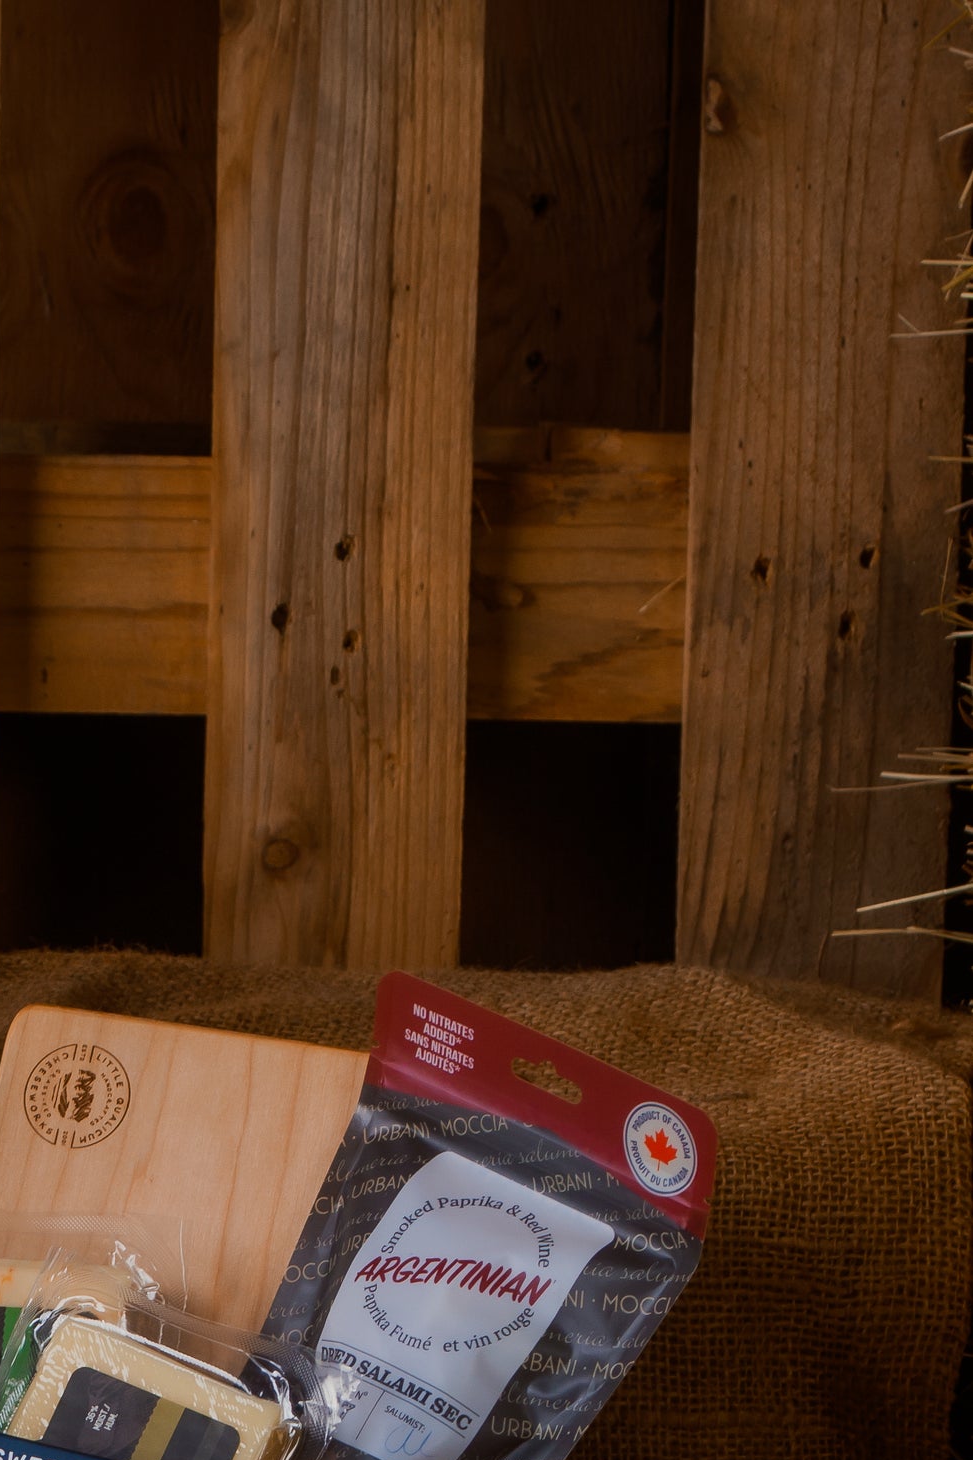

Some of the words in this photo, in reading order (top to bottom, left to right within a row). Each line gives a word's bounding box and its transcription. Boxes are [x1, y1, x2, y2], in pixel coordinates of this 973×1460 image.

[412, 1003, 427, 1019] NO
[428, 1010, 475, 1041] NITRATES
[96, 1053, 124, 1088] LITTLE
[404, 1028, 429, 1049] SANS
[430, 1040, 475, 1069] NITRATES
[29, 1052, 69, 1135] CHEESEWORKS
[79, 1097, 125, 1144] QUALICUM
[363, 1121, 431, 1145] URBANI
[440, 1113, 509, 1137] MOCCIA
[632, 1110, 661, 1132] PRODUCT
[662, 1114, 672, 1125] OF
[672, 1122, 691, 1159] CANADA
[532, 1172, 592, 1194] URBANI
[630, 1140, 651, 1178] PRODUIT
[650, 1174, 661, 1186] DU
[663, 1167, 689, 1187] CANADA
[381, 1200, 435, 1254] Smoked
[438, 1196, 504, 1210] Paprika
[506, 1205, 521, 1217] &
[520, 1212, 547, 1234] Red
[537, 1233, 554, 1268] Wine
[613, 1231, 689, 1252] MOCCIA
[354, 1256, 552, 1306] ARGENTINIAN
[363, 1283, 390, 1332] Paprika
[389, 1324, 432, 1351] Fumé
[443, 1339, 459, 1353] et
[464, 1335, 492, 1350] vin
[493, 1307, 535, 1342] rouge
[603, 1294, 677, 1315] MOCCI
[356, 1360, 432, 1406] SALAMI
[430, 1398, 472, 1430] SEC
[491, 1416, 564, 1440] URBANI
